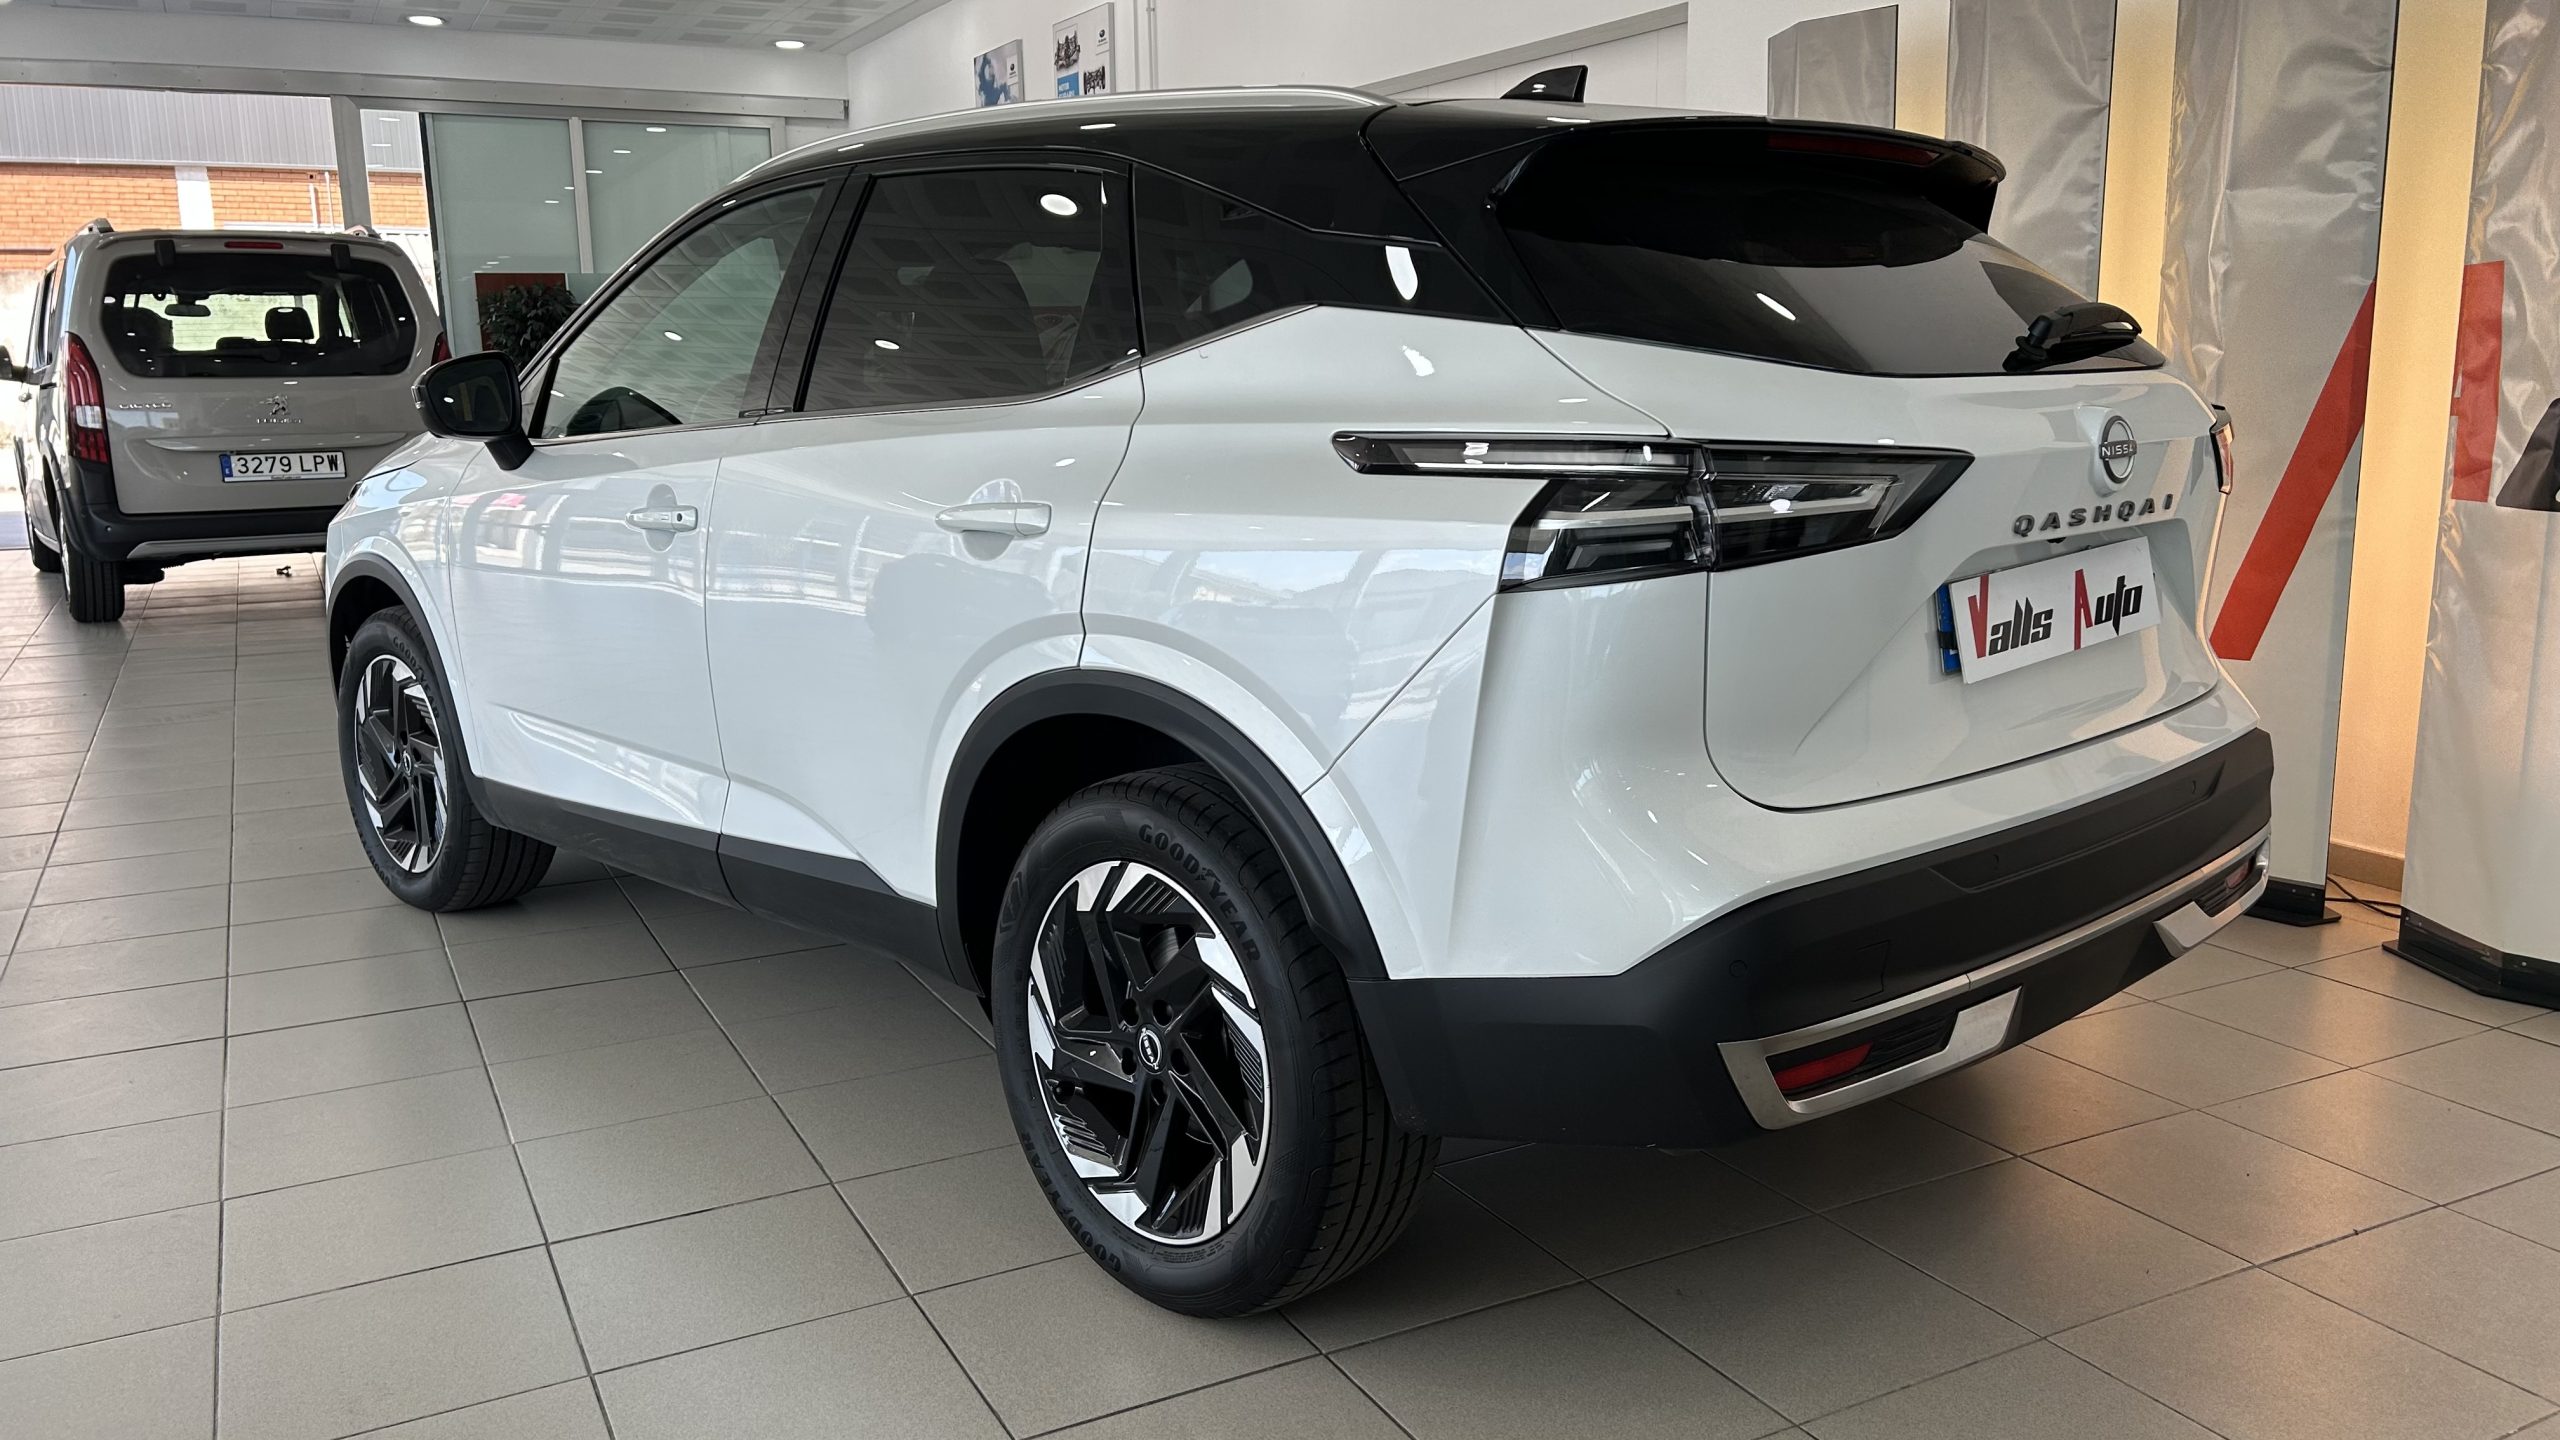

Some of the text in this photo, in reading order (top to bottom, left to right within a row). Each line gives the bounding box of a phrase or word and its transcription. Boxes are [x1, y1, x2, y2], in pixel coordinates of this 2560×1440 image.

[236, 454, 338, 474] 3279 LPW
[2013, 493, 2174, 537] QASHQAI
[1968, 568, 2143, 659] Valls Auto
[1138, 823, 1261, 961] GOODYEAR
